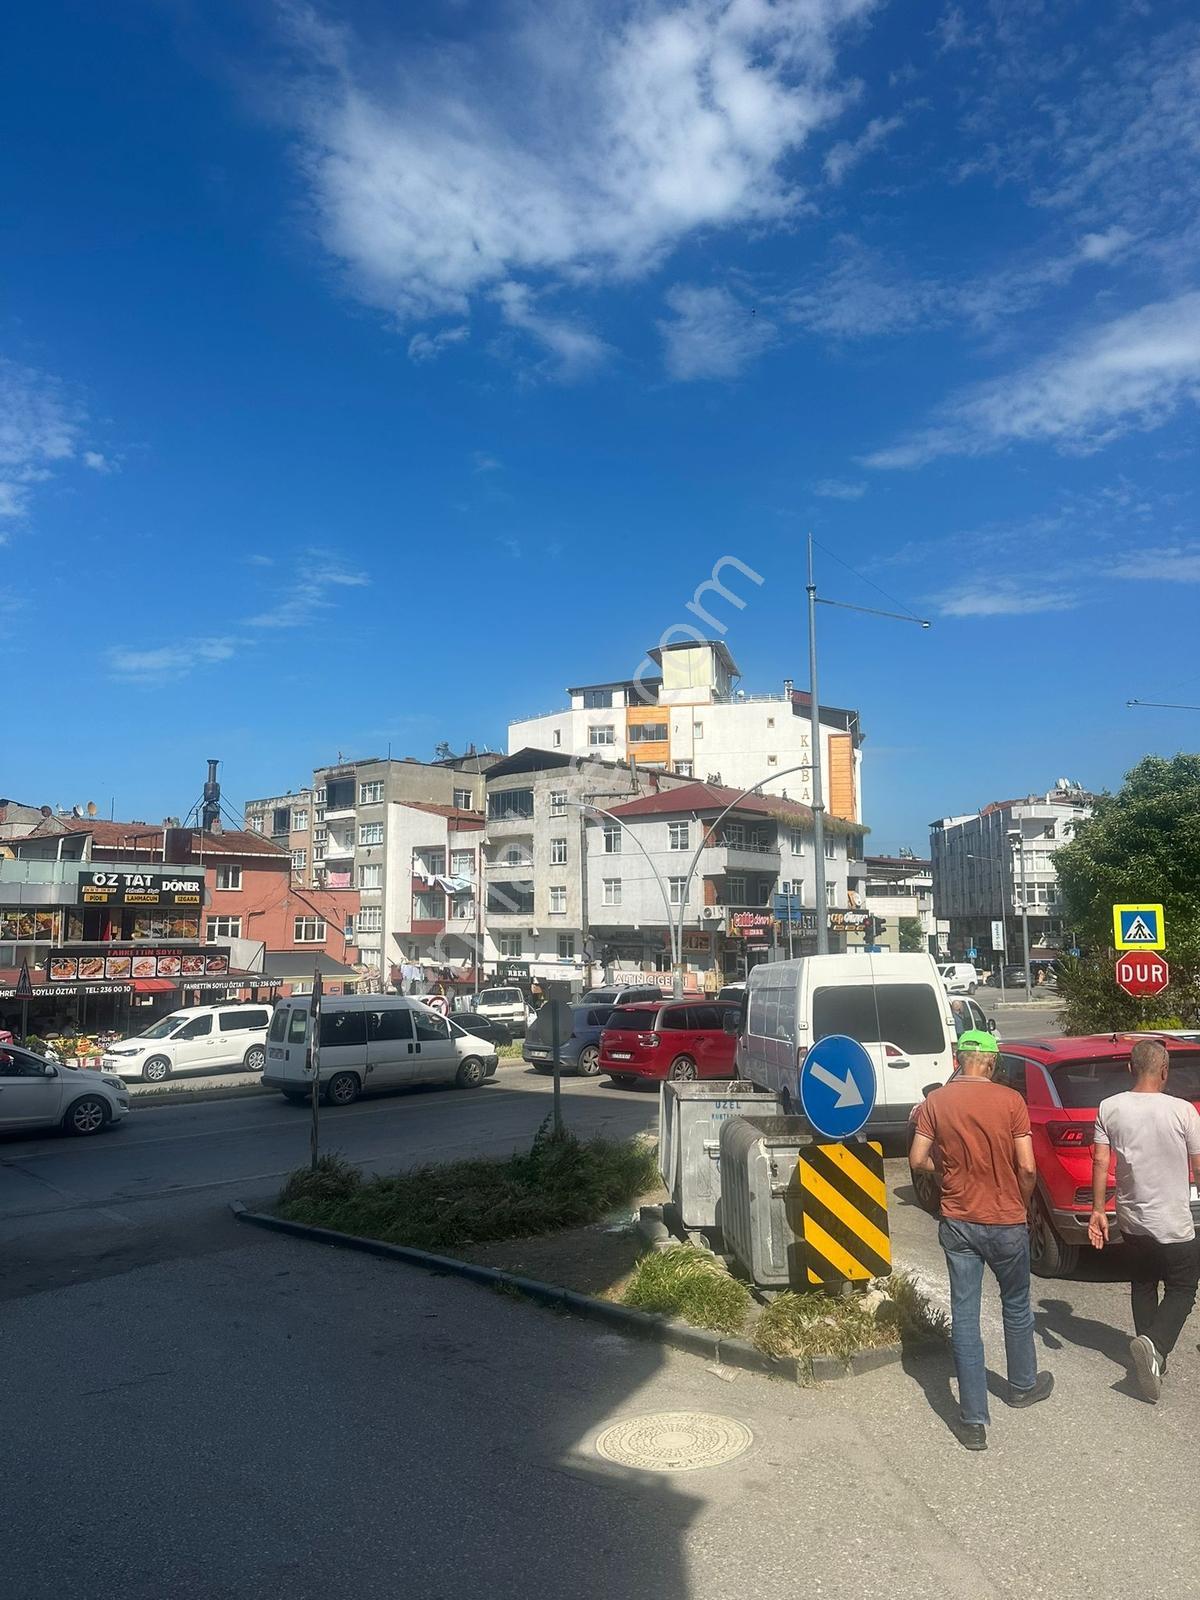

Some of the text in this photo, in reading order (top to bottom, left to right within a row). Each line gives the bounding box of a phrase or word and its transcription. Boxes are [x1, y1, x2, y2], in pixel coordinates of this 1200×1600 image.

[92, 872, 154, 887] ÖZ TAT
[162, 879, 200, 892] DÖNER
[1121, 964, 1163, 983] DUR
[32, 988, 54, 996] SOYLU
[55, 987, 78, 995] ÖZTAT
